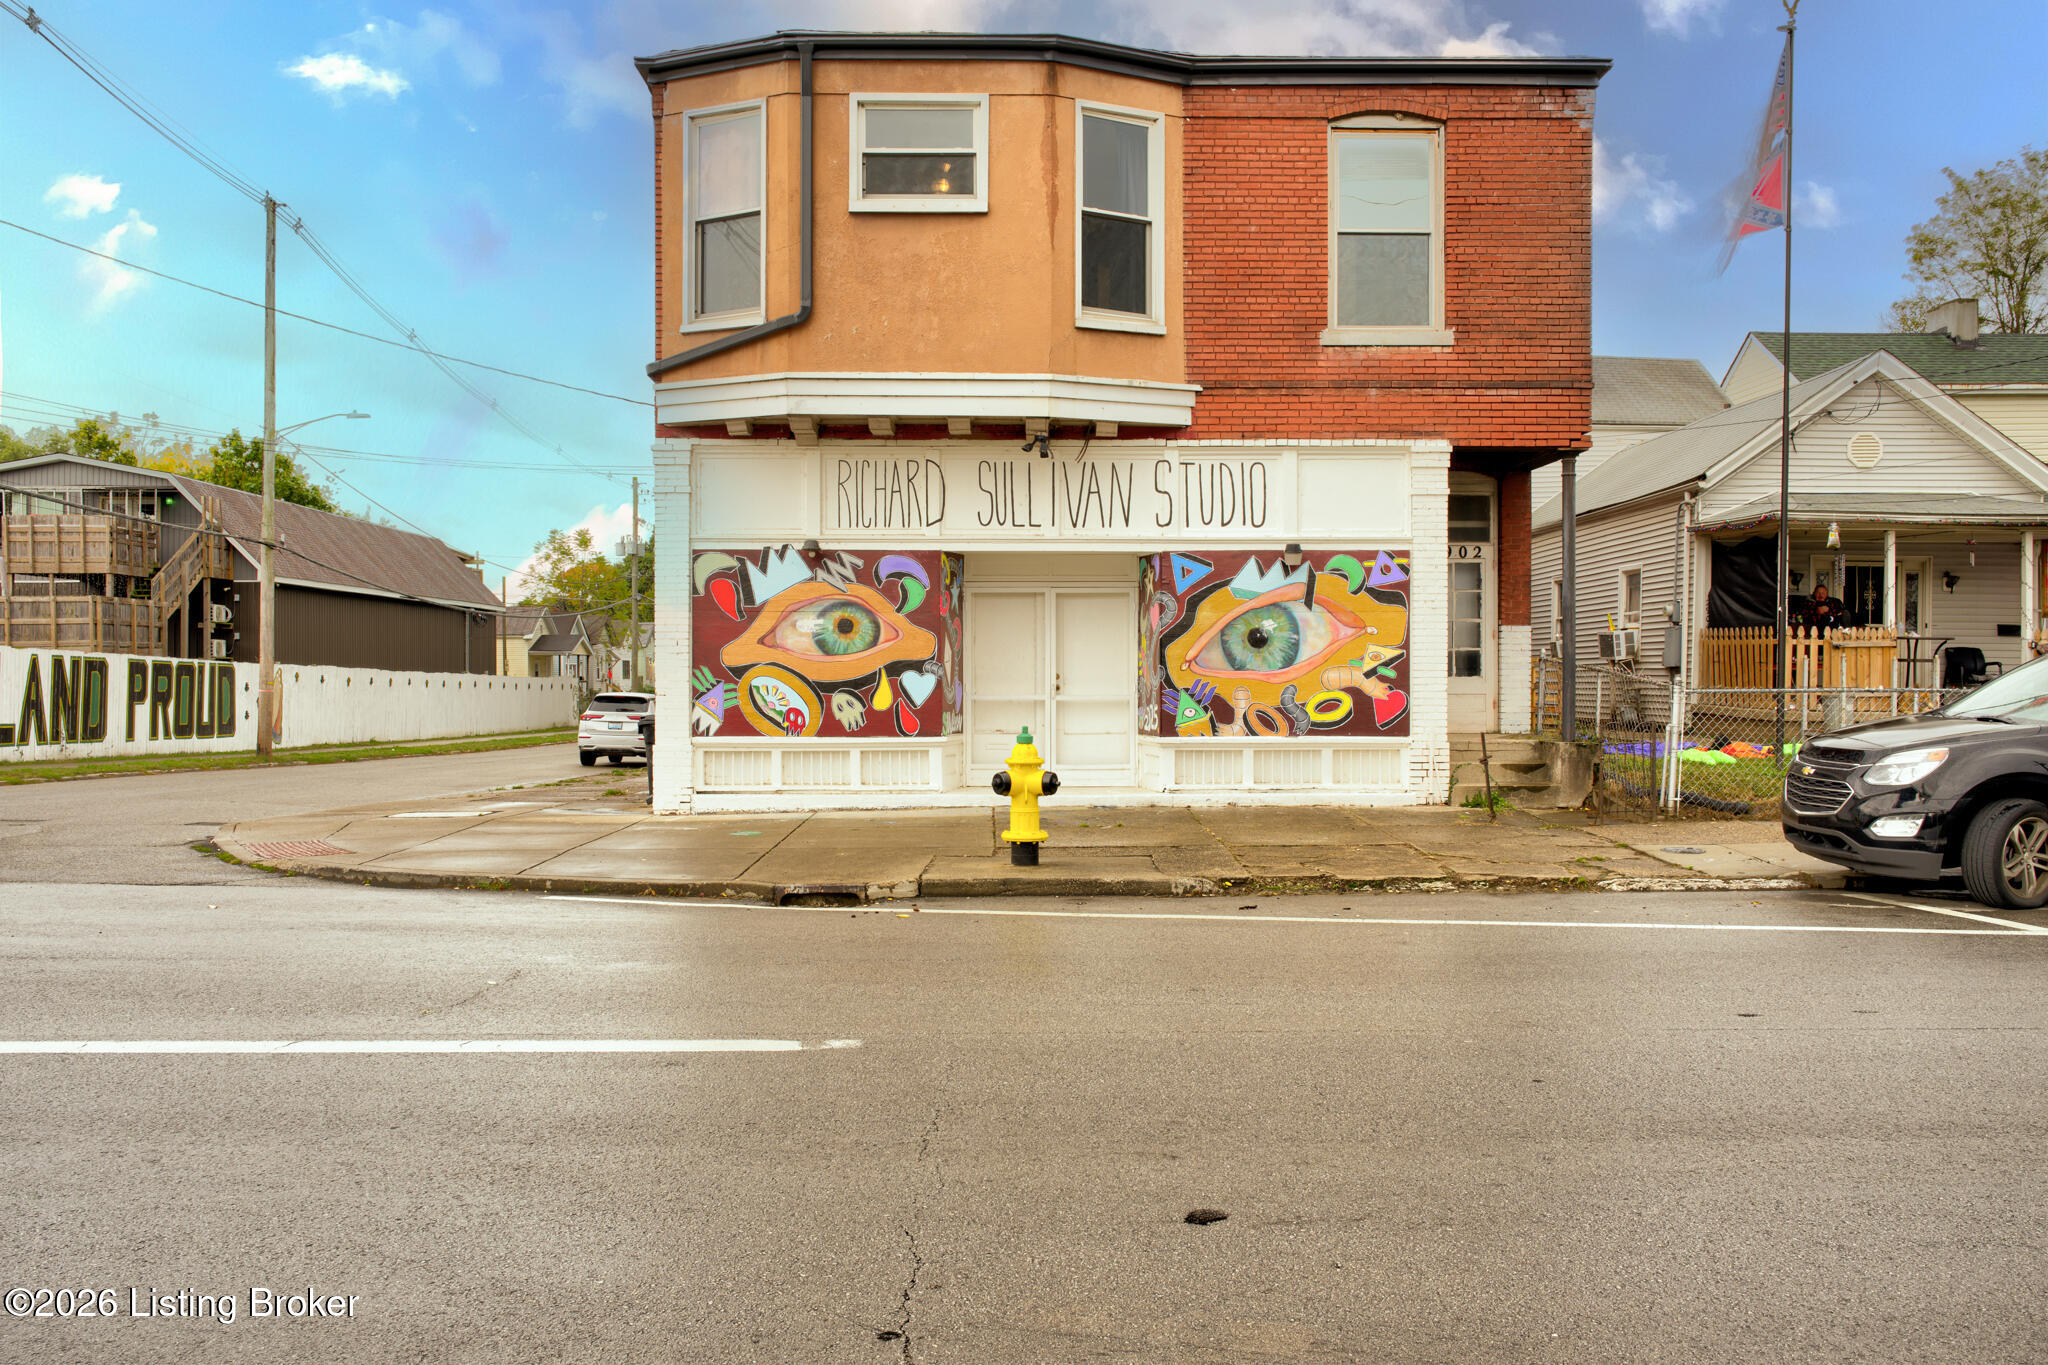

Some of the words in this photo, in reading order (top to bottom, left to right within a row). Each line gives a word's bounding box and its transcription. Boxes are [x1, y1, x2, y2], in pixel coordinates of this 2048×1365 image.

[838, 459, 946, 528] RICHARD
[977, 460, 1133, 528] SULLIVAN
[1154, 459, 1267, 528] STUDIO
[125, 658, 236, 742] PROUD
